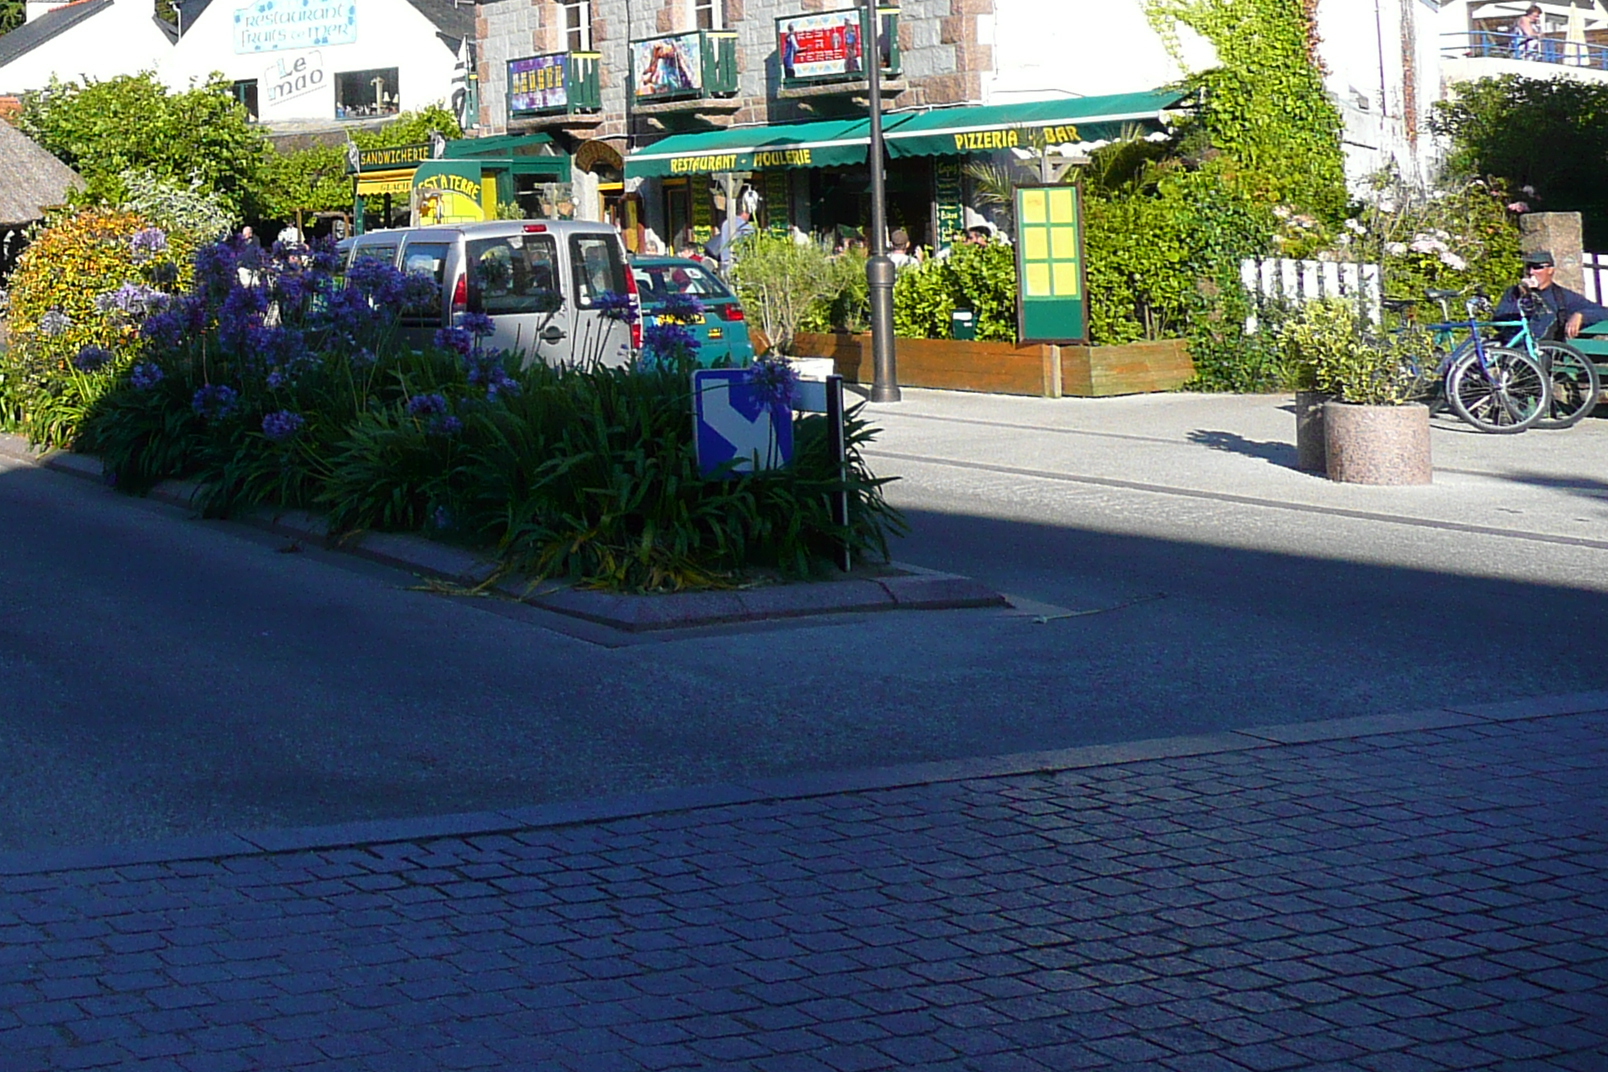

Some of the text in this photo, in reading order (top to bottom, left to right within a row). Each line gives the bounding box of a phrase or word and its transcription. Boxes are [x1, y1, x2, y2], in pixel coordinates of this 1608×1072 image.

[276, 57, 307, 79] Le
[269, 69, 323, 101] mao
[954, 125, 1082, 150] PIZZERIA BAR
[360, 146, 429, 165] SANDWICHERIE
[670, 154, 737, 173] RESTAURANT
[381, 182, 411, 191] GLACIE
[448, 174, 481, 200] TERRE
